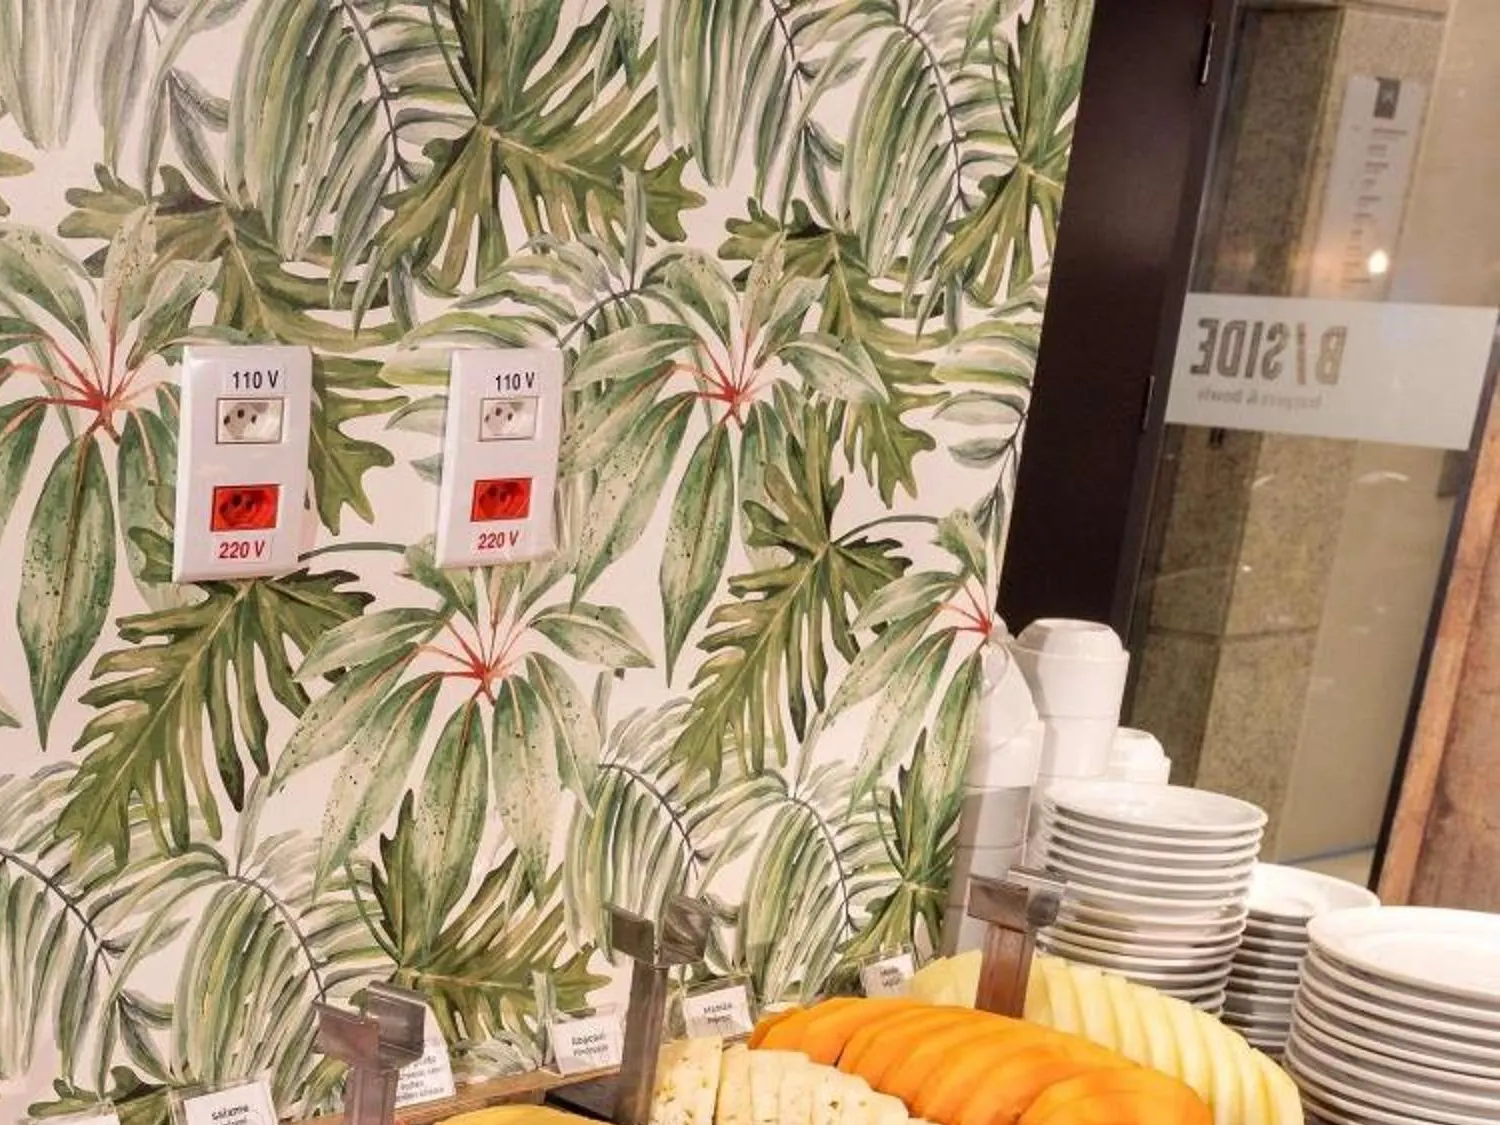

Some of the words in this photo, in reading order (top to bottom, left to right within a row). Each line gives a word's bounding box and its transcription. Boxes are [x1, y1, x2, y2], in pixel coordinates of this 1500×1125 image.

[232, 371, 263, 389] 110
[267, 370, 279, 388] V
[495, 373, 521, 391] 110
[523, 371, 535, 389] V
[219, 542, 251, 559] 220
[253, 540, 265, 558] V
[477, 532, 505, 550] 220
[507, 531, 519, 548] V
